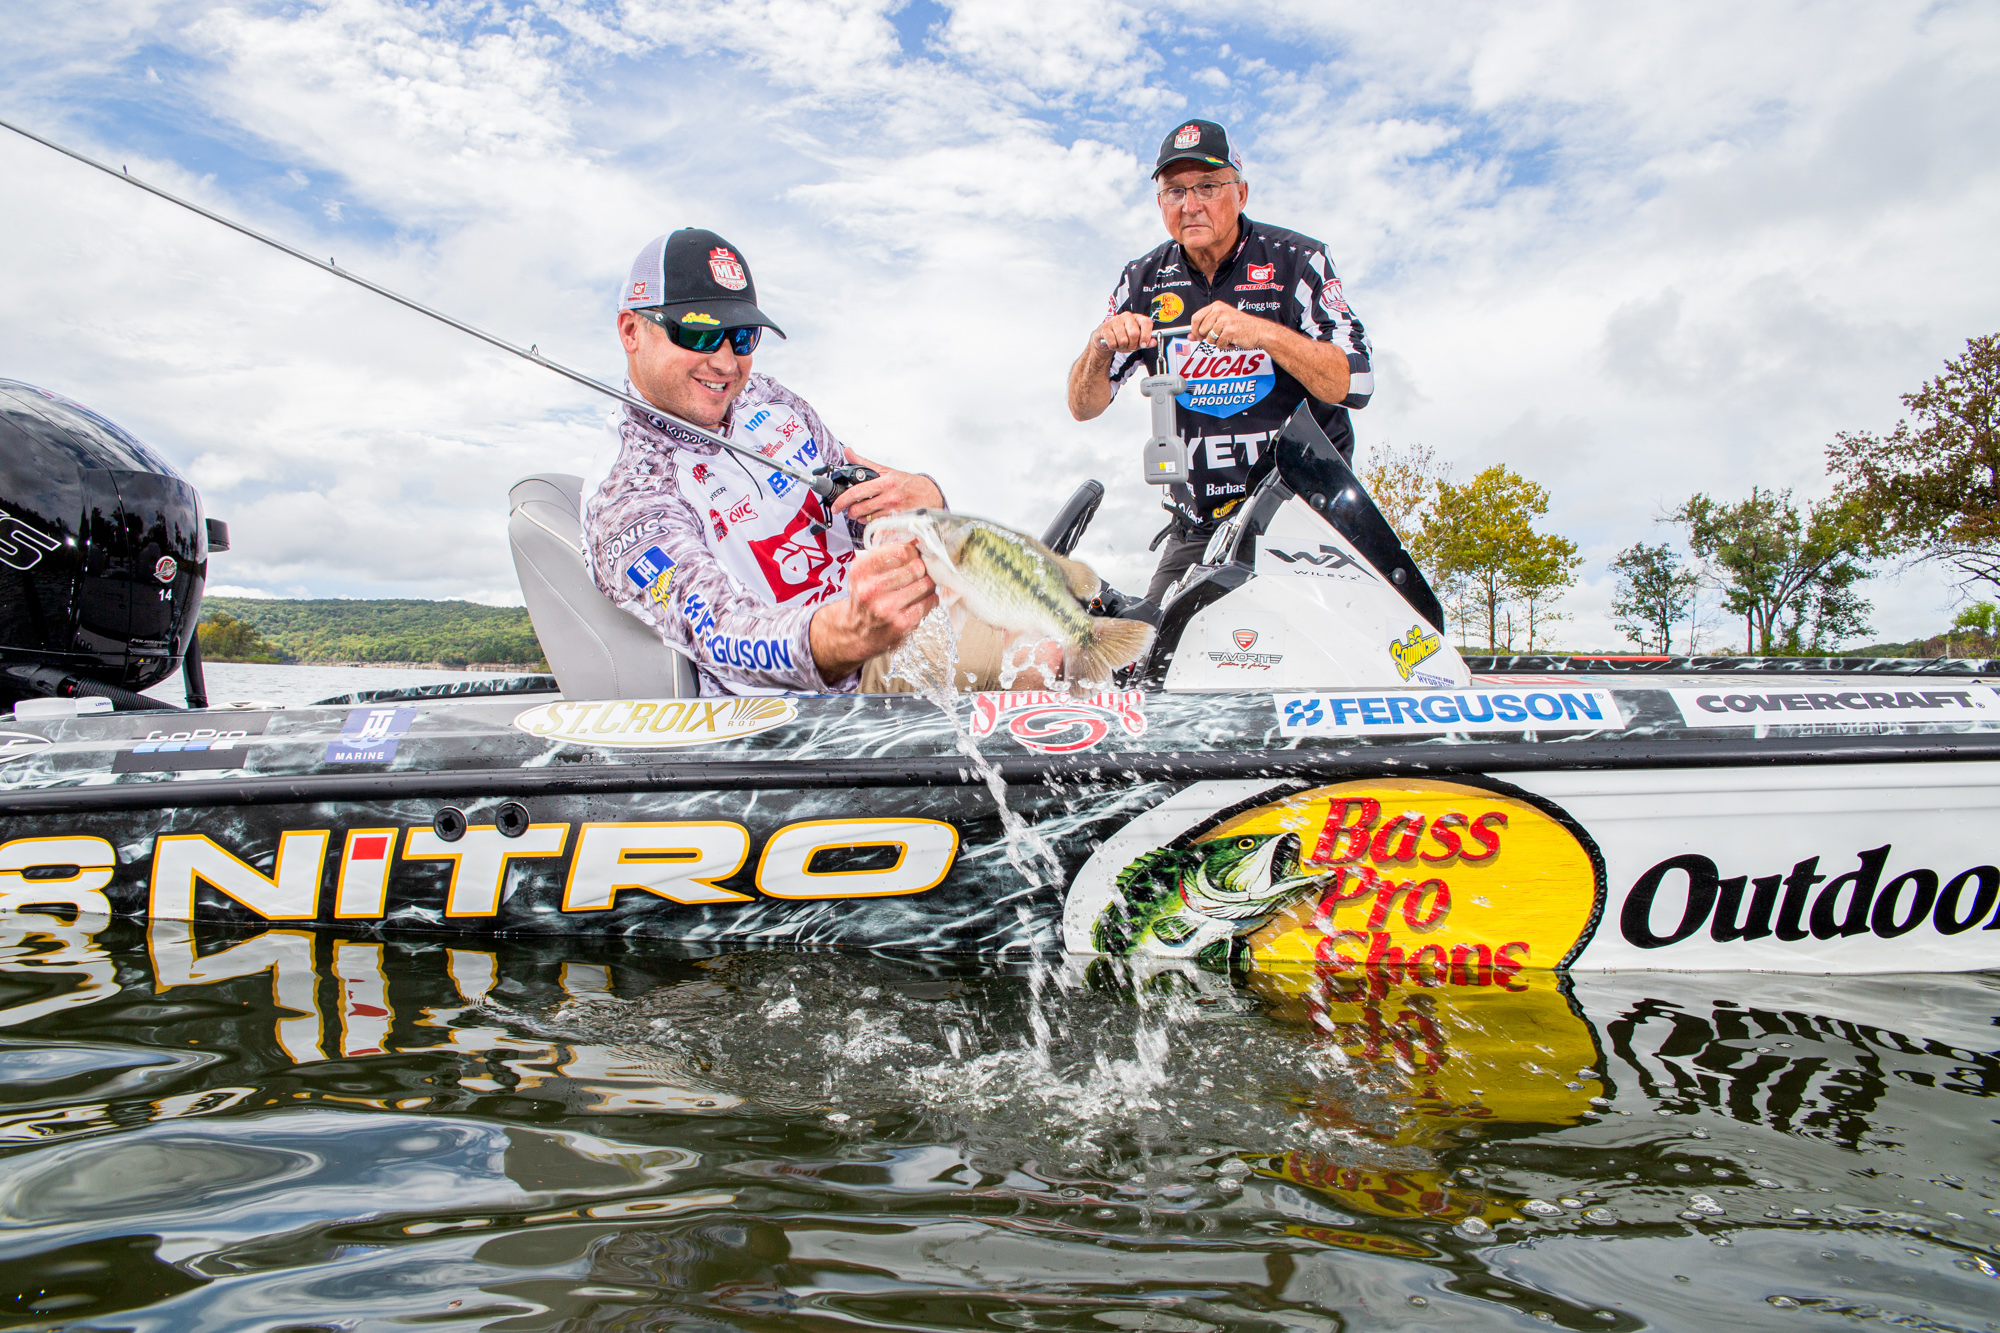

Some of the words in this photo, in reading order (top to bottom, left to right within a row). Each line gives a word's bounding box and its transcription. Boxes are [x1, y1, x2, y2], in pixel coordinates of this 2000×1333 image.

[1176, 133, 1198, 144] MLF
[713, 264, 743, 280] MLF
[1180, 353, 1265, 379] LUCAS
[1193, 380, 1257, 396] MARINE
[1189, 394, 1256, 408] PRODUCTS
[1206, 483, 1246, 496] Barbas
[606, 518, 660, 566] SONIC
[158, 588, 173, 601] 14
[1208, 652, 1283, 665] FAVORITE
[1329, 692, 1604, 726] FERGUSON
[1697, 692, 1974, 714] COVERCRAFT
[727, 720, 756, 728] ROD
[145, 729, 248, 742] GoPro
[335, 751, 384, 760] MARINE
[1304, 797, 1508, 865] Bass
[151, 817, 960, 922] NITRO
[1302, 866, 1451, 931] Pro
[1620, 844, 2000, 950] Outdoo
